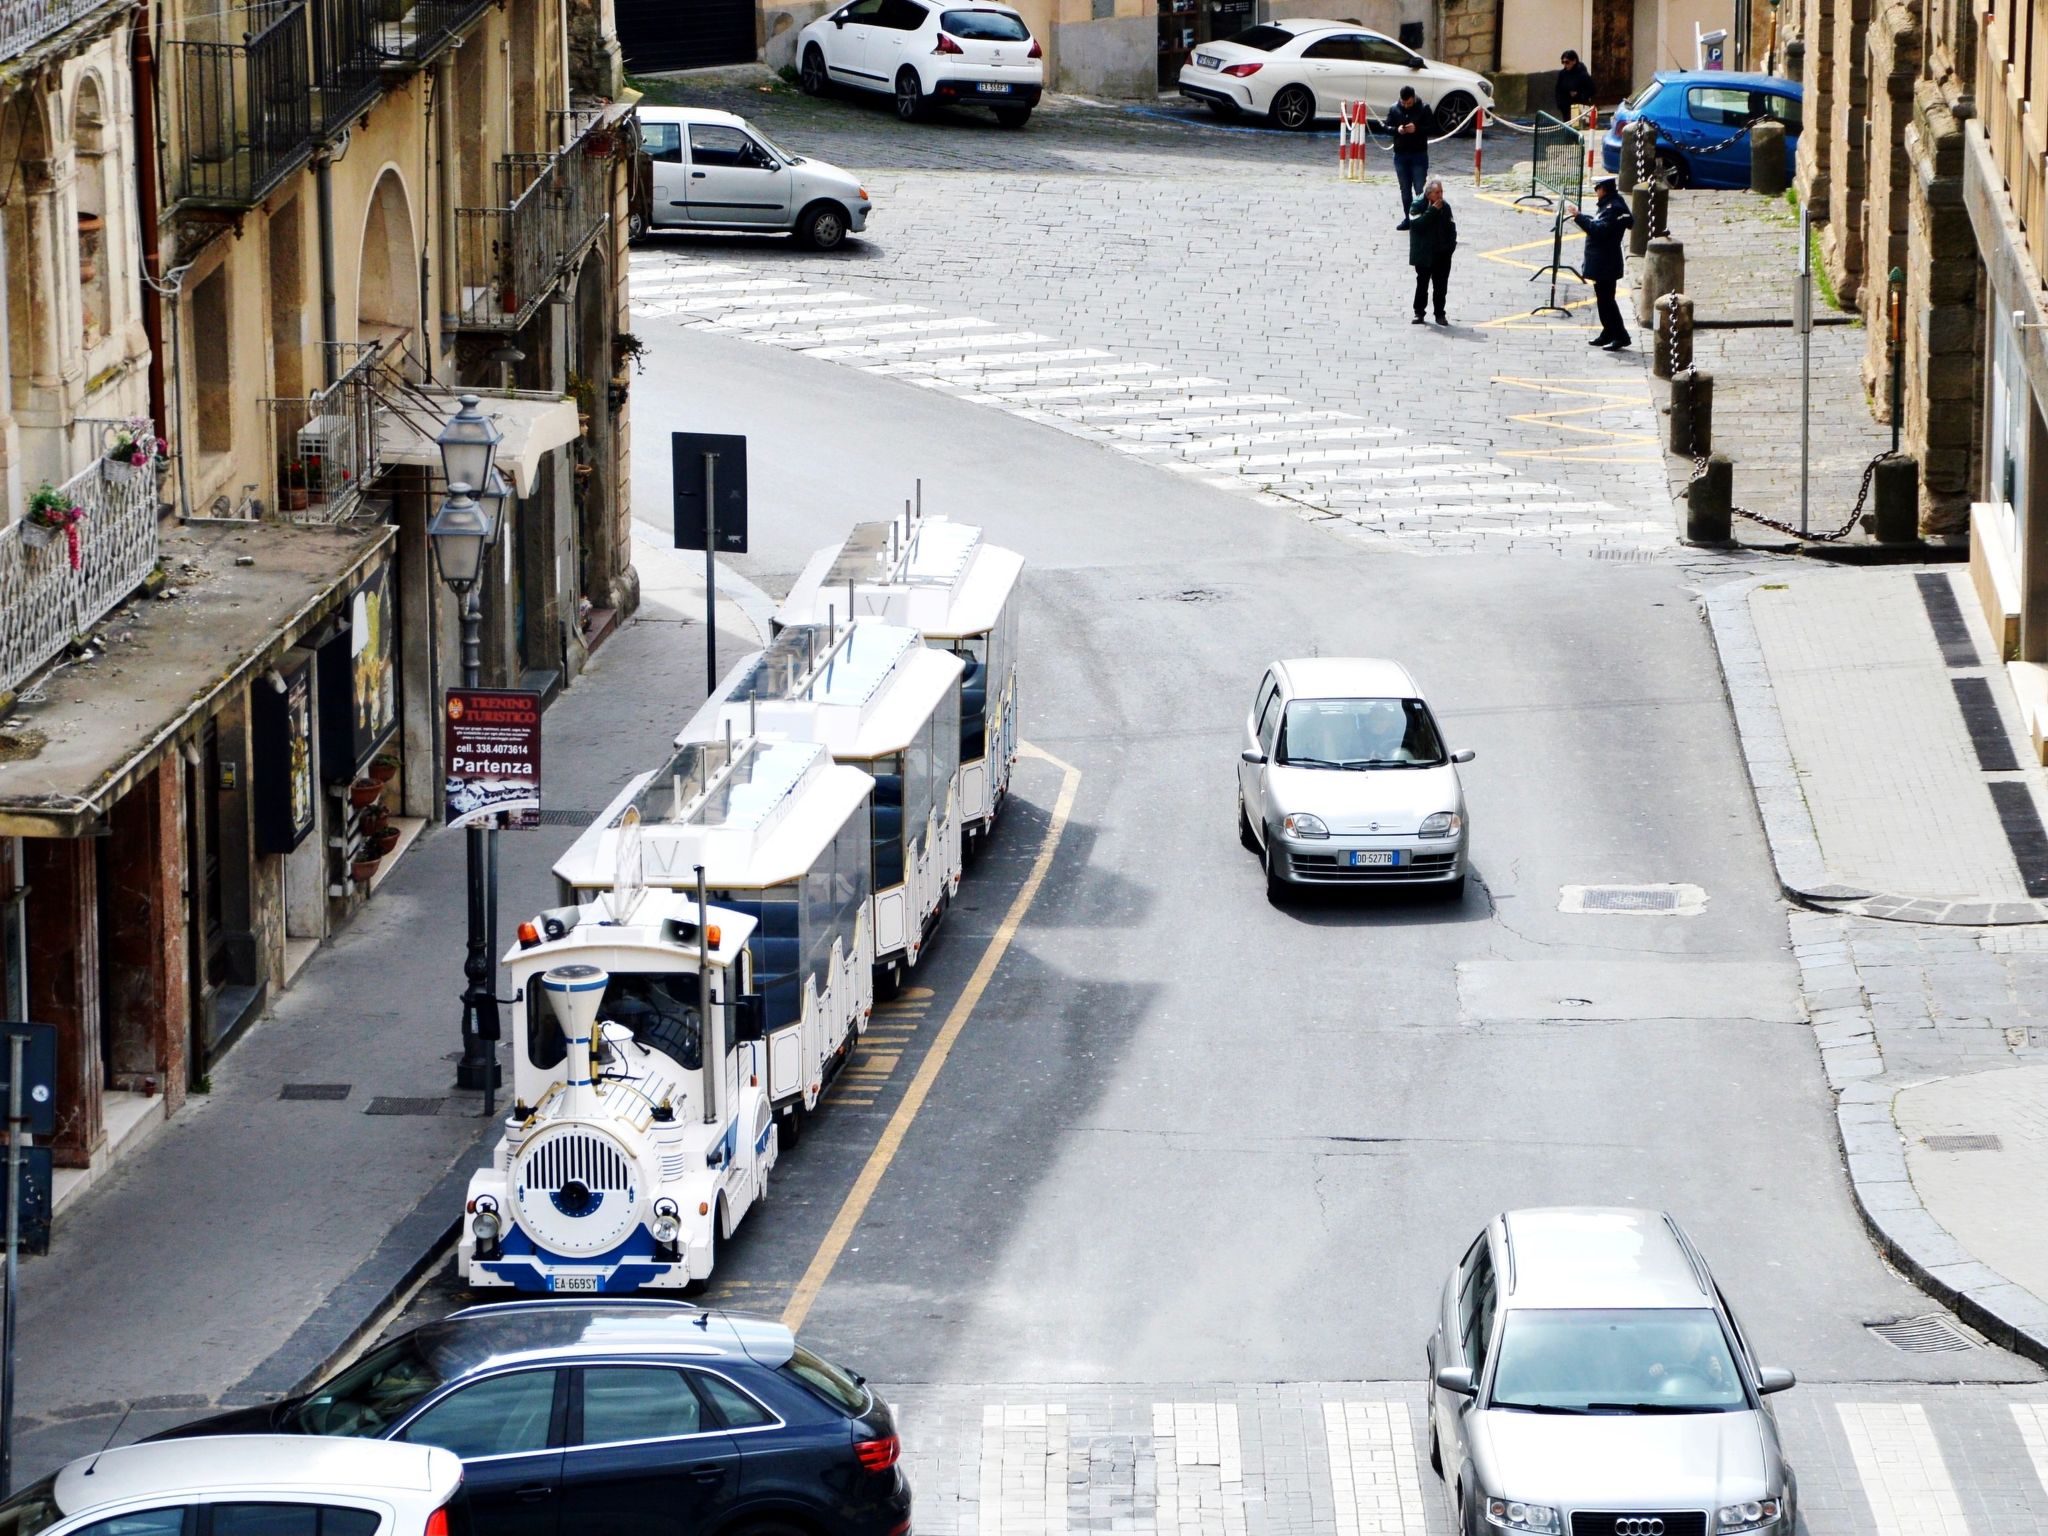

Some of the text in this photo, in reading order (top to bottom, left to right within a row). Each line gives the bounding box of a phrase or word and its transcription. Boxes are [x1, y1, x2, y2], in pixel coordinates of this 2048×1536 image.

[1712, 49, 1720, 60] P
[471, 697, 532, 710] TRENINO
[466, 711, 536, 723] TURISTICO
[456, 744, 528, 754] cell. 338.4073614
[452, 757, 532, 774] Partenza
